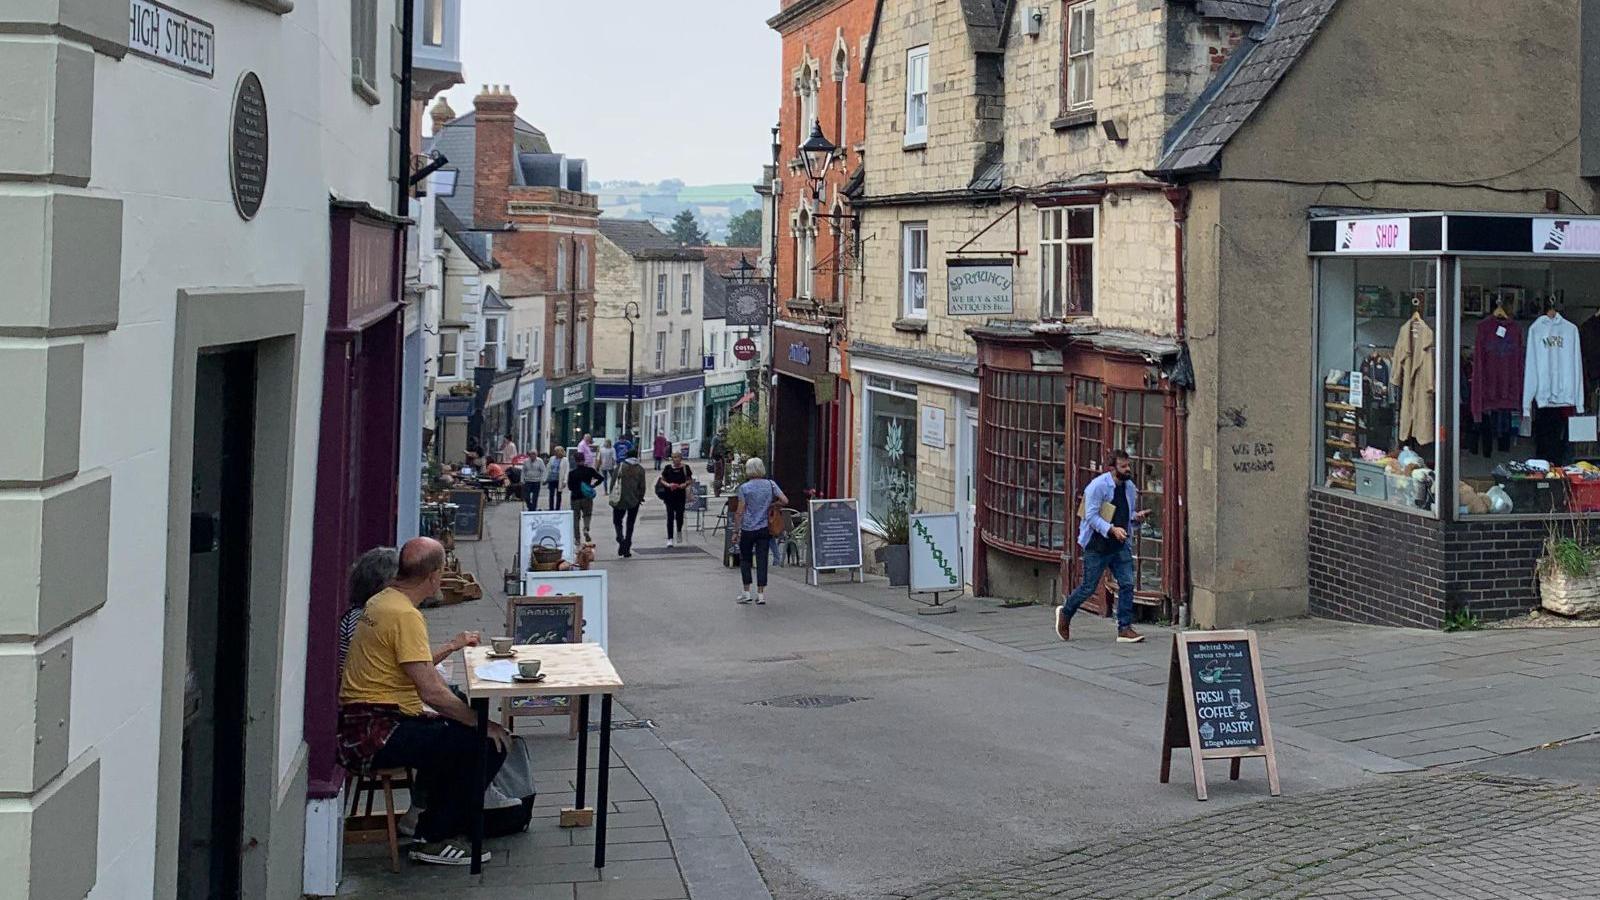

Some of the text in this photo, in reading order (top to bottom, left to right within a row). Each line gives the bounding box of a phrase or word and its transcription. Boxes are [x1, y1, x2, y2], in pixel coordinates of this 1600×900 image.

[165, 17, 212, 66] STREET
[1375, 224, 1399, 248] SHOP
[950, 270, 1011, 291] SPRAUNCY
[952, 295, 965, 303] WE
[966, 295, 982, 303] BUY
[993, 295, 1009, 303] SELL
[951, 303, 991, 312] ANTIQUES
[1231, 443, 1250, 455] WE
[912, 518, 957, 585] ANTIQUES
[1195, 690, 1225, 704] FRESH
[1198, 706, 1248, 720] COFFEE &
[1219, 720, 1255, 734] PASTRY
